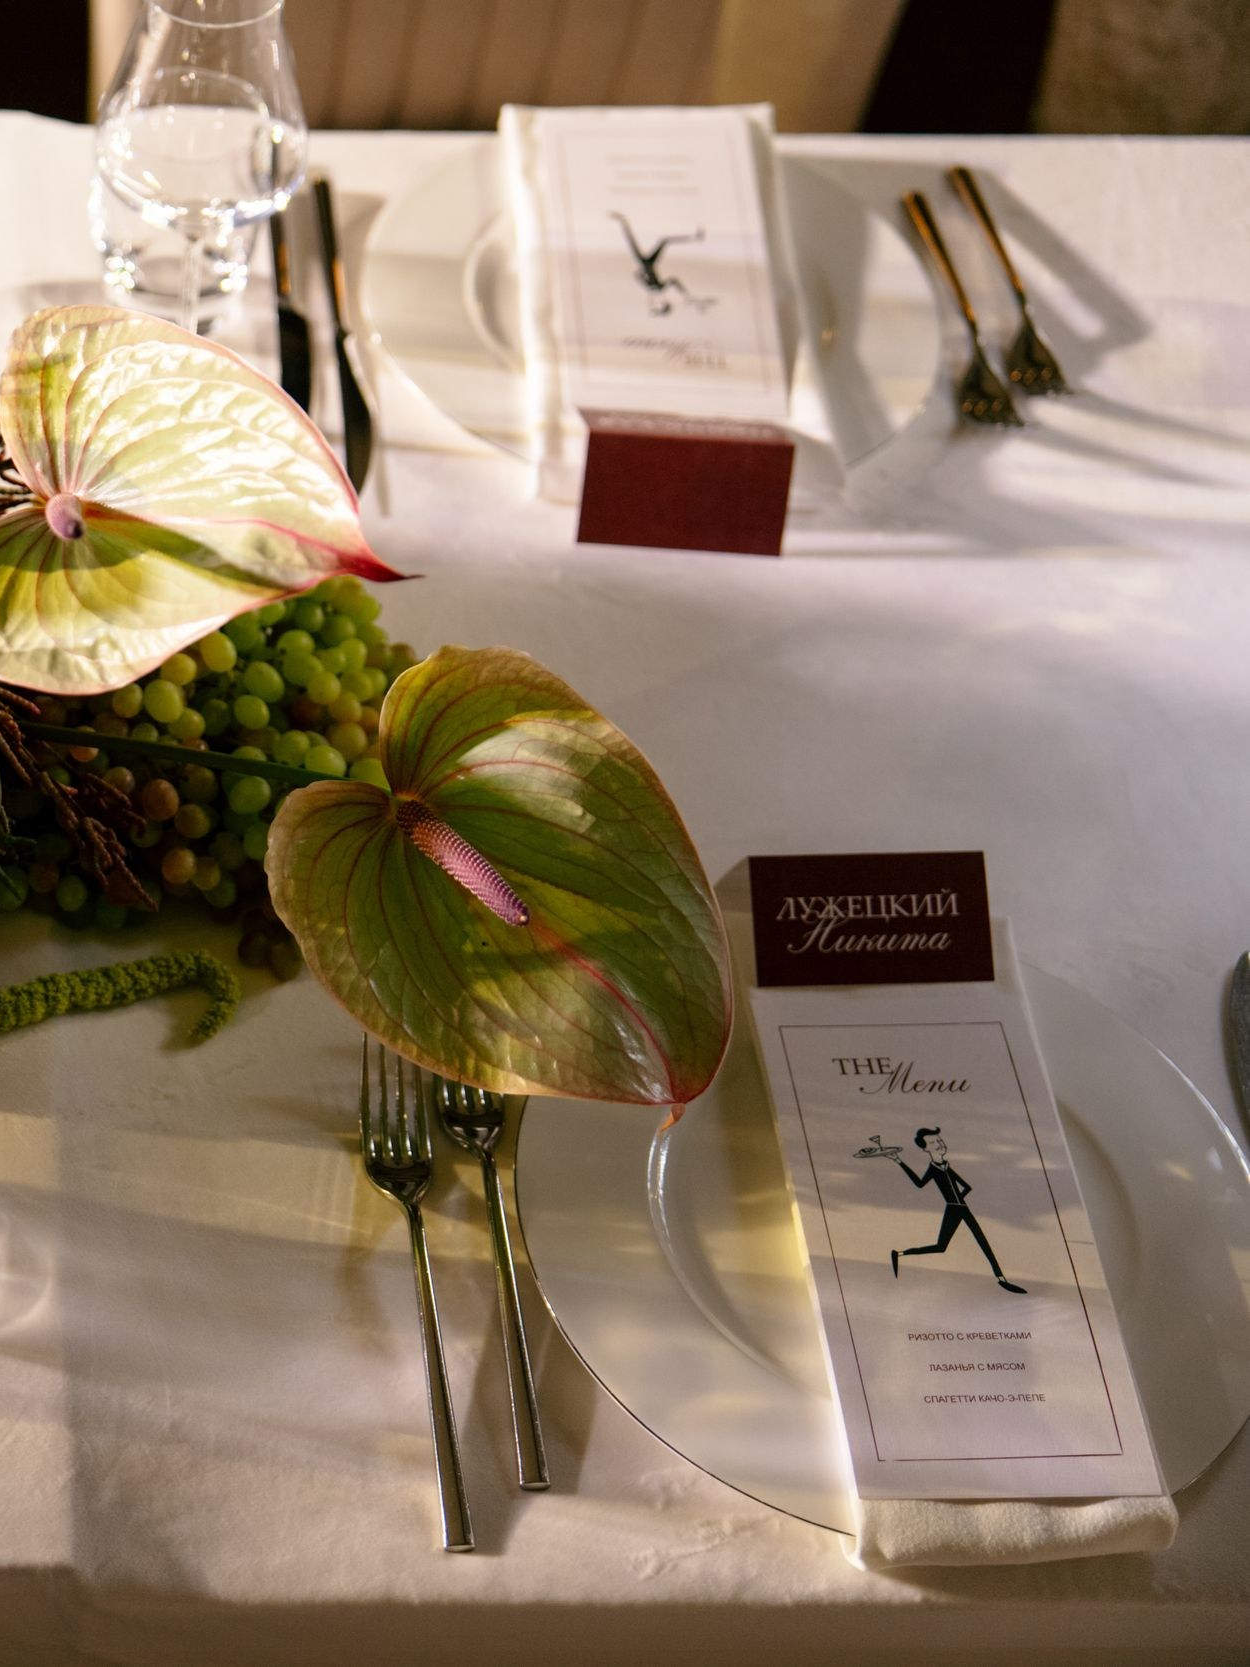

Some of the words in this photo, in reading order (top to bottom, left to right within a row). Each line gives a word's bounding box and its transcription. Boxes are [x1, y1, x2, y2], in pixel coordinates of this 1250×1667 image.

[776, 888, 959, 922] ЛУЖЕЦКИЙ
[787, 904, 952, 953] Никита
[832, 1057, 895, 1076] THE
[858, 1061, 971, 1094] Menu
[908, 1333, 955, 1342] РИЗОТТО
[956, 1333, 964, 1341] С
[966, 1331, 1032, 1341] КРЕВЕТКАМИ
[929, 1363, 976, 1372] ЛАЗАНЬЯ
[977, 1363, 985, 1372] С
[986, 1362, 1026, 1371] МЯСОМ
[924, 1395, 976, 1404] СПАГЕТТИ
[978, 1393, 1046, 1403] КАЧО-Э-ПЕПЕ
